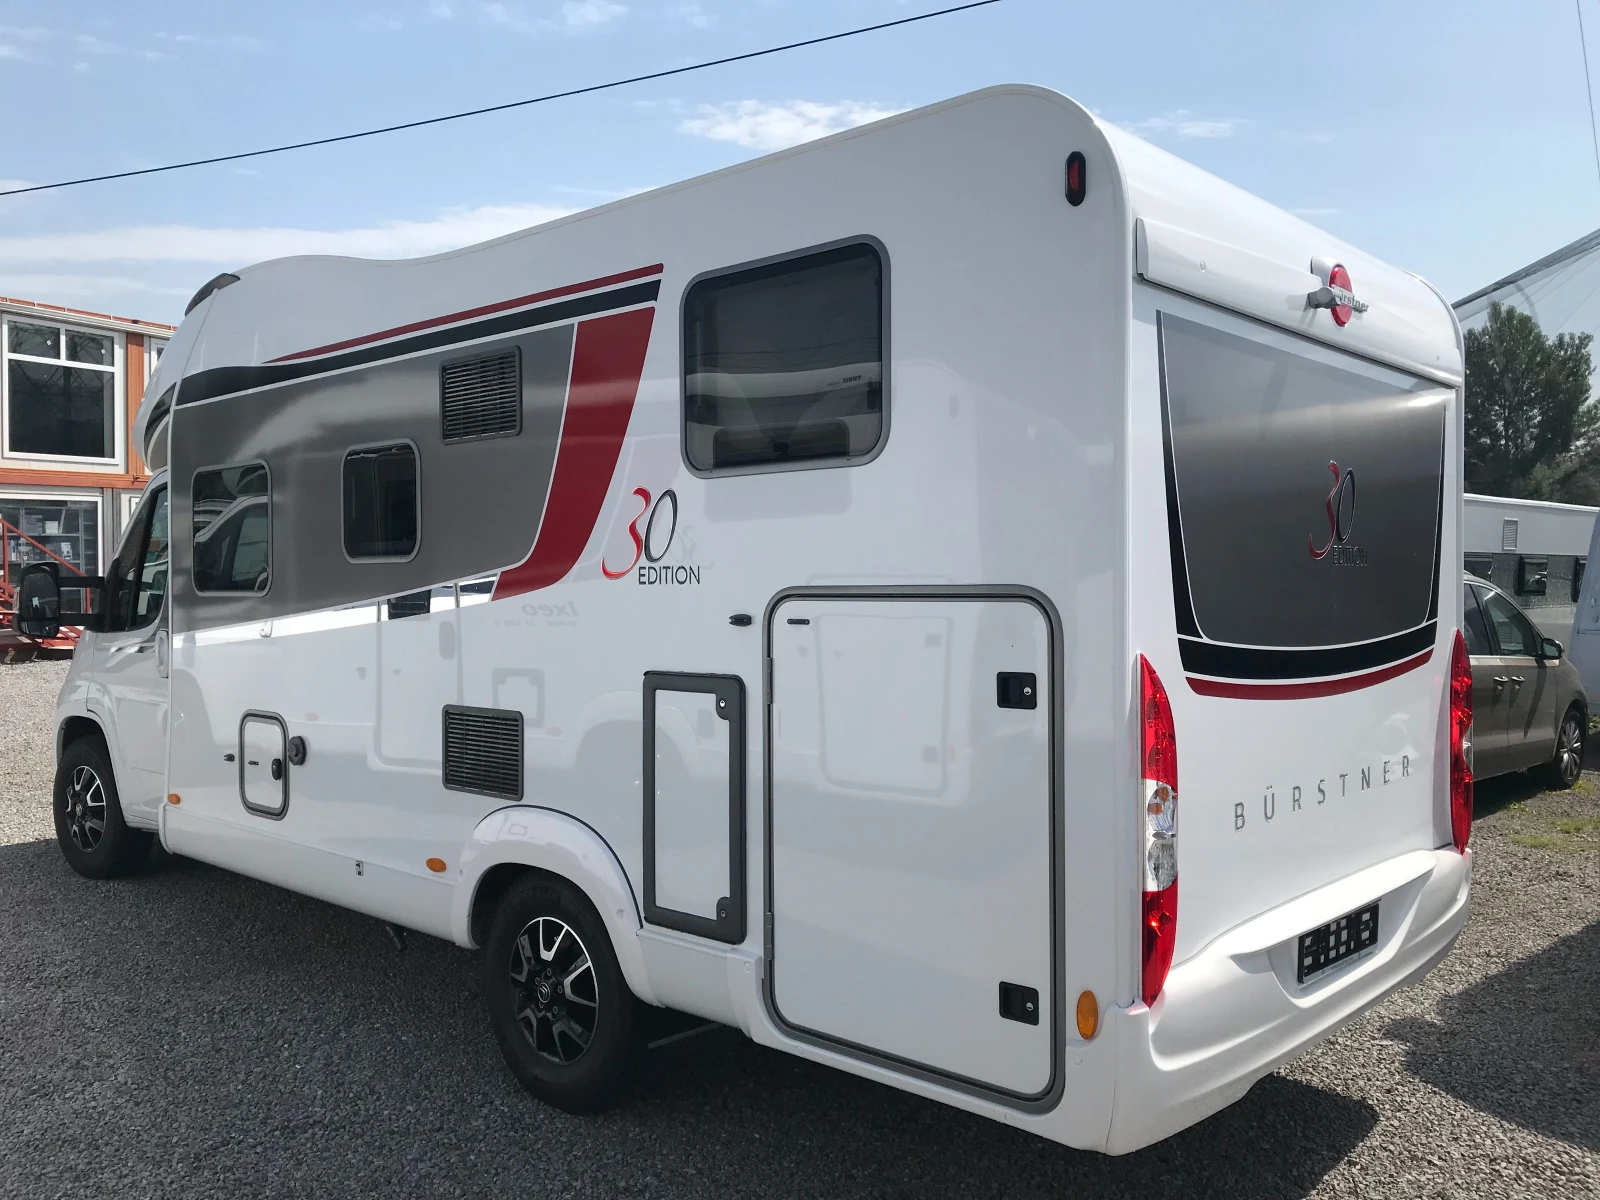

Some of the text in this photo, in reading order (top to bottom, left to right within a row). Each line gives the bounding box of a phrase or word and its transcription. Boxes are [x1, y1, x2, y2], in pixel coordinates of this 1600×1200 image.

[1332, 286, 1369, 312] ürstner
[600, 486, 678, 580] 30
[1308, 460, 1356, 560] 30
[638, 565, 700, 585] EDITION
[1333, 545, 1368, 567] EDITION
[1234, 755, 1410, 832] BÜRSTNER
